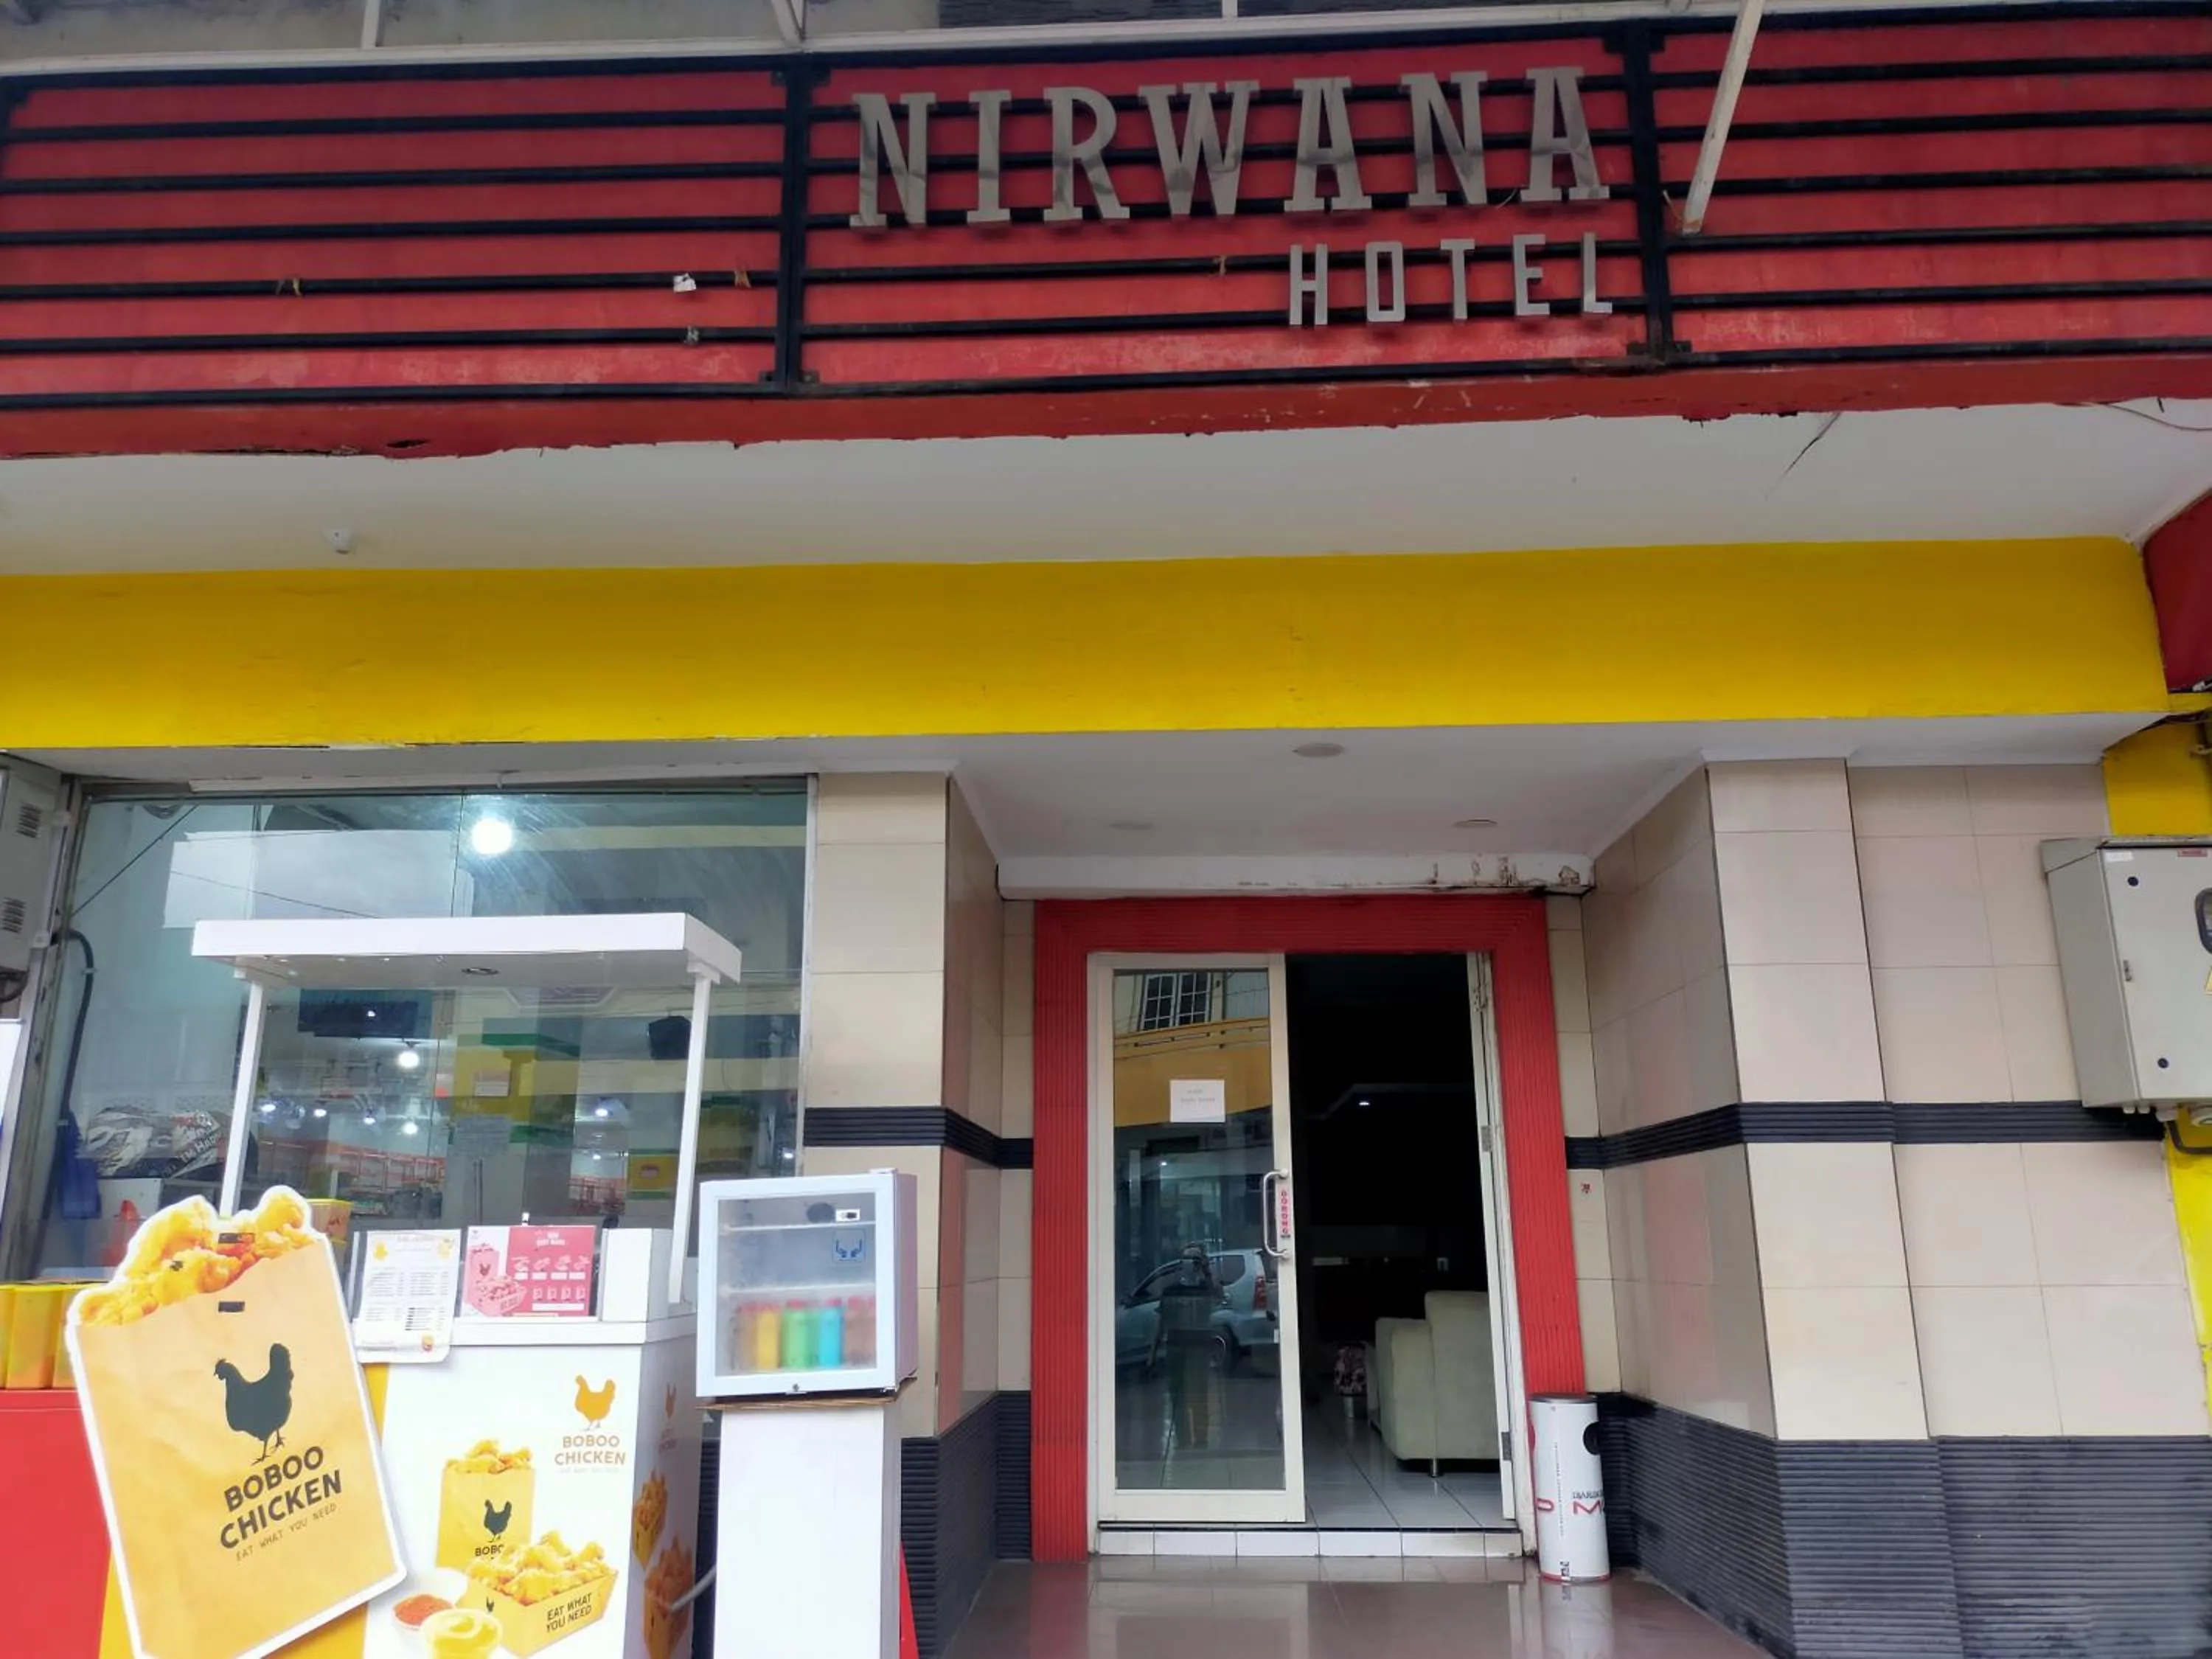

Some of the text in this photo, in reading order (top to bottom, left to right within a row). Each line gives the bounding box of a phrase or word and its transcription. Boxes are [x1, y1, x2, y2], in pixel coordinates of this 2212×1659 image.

[849, 66, 1612, 228] NIRWANA
[1288, 232, 1613, 327] HOTEL
[554, 1451, 626, 1465] CHICKEN
[563, 1435, 620, 1448] BOBOO
[223, 1446, 324, 1512] BOBOO
[220, 1470, 342, 1549] CHICKEN
[236, 1503, 337, 1562] EAT WHAT YOU NEED
[546, 1604, 592, 1632] YOU NEED
[548, 1592, 592, 1621] EAT WHAT
